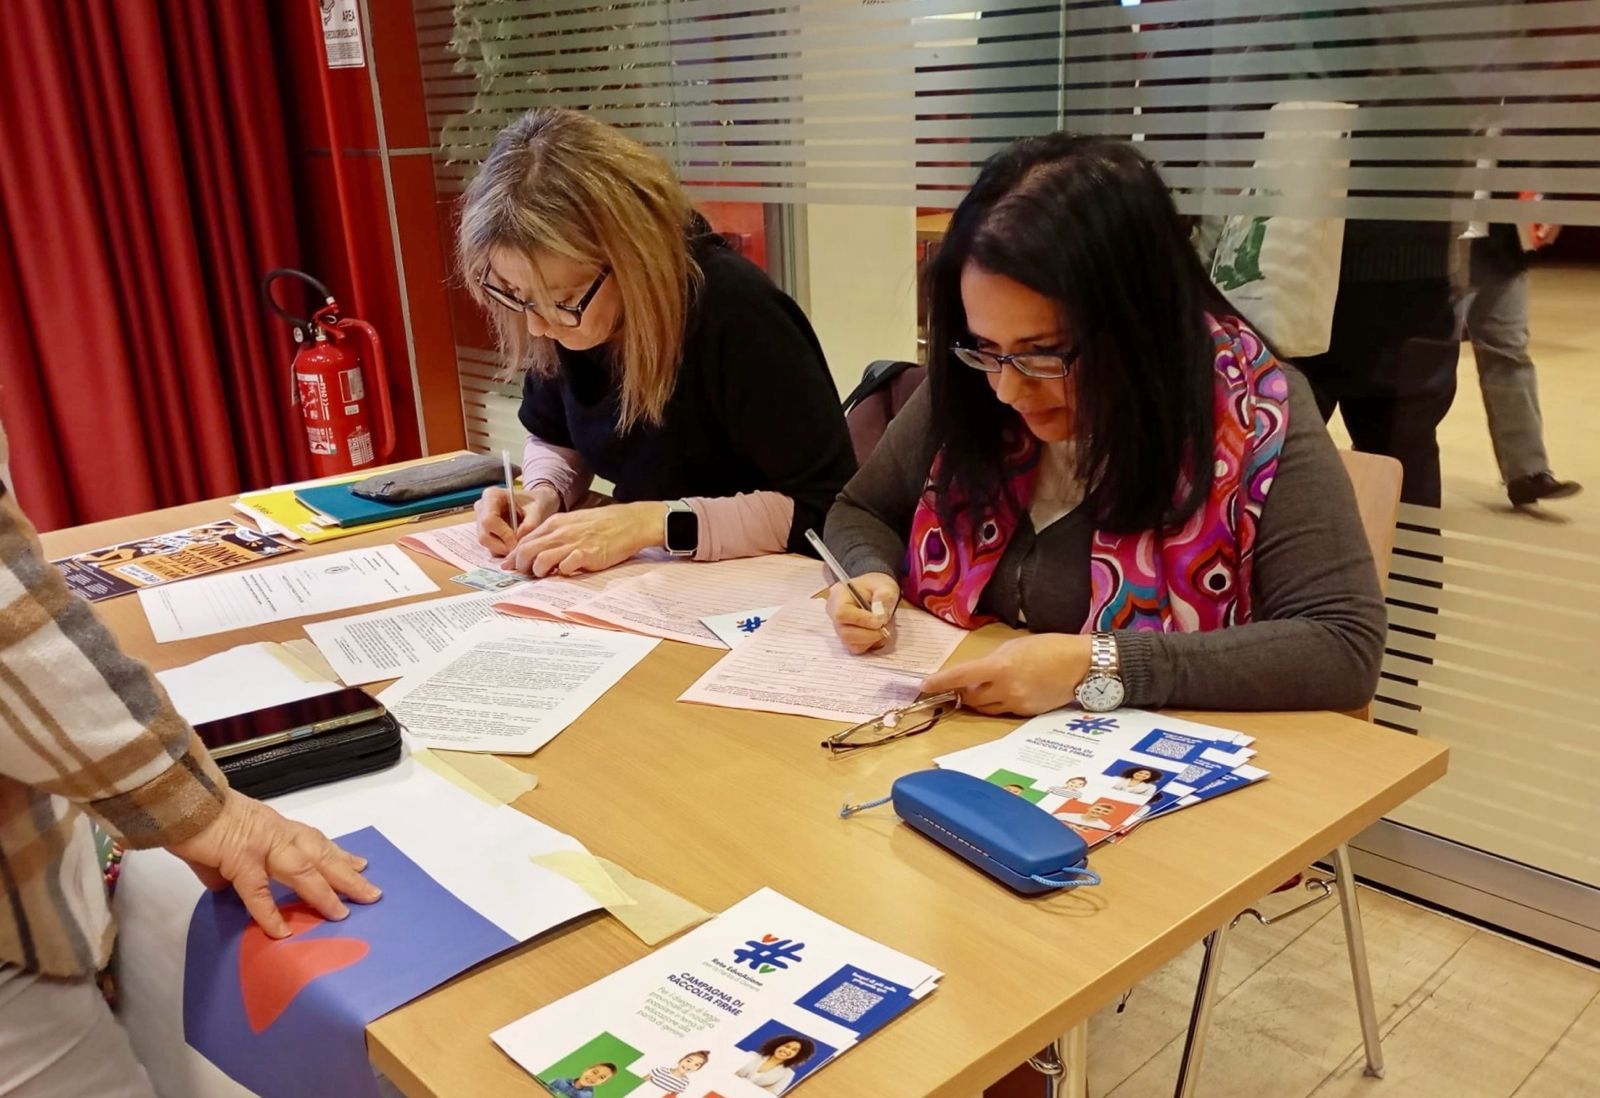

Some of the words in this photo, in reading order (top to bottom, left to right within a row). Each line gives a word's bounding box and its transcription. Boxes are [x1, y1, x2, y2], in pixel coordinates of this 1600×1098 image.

[667, 974, 713, 1002] RACCOLTA
[713, 998, 743, 1016] FIRME
[681, 972, 731, 1003] CAMPAGNA
[731, 999, 744, 1008] DI
